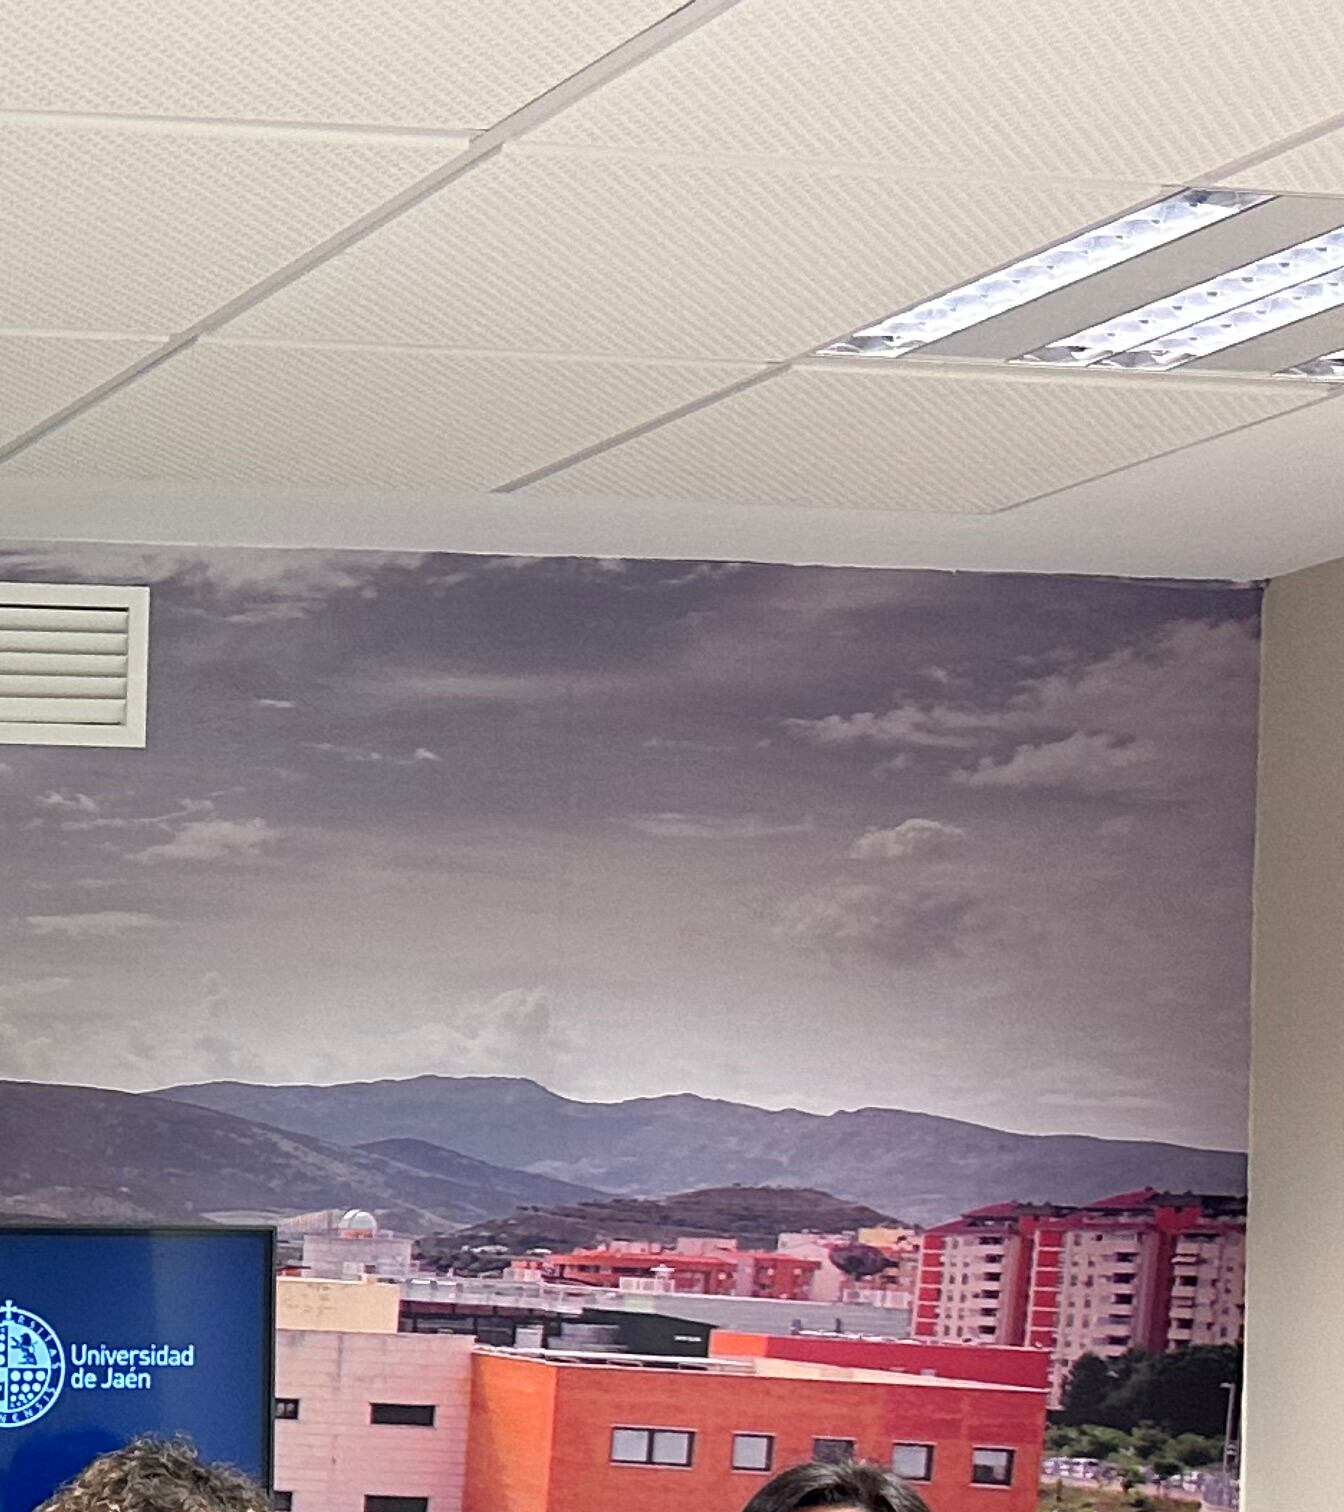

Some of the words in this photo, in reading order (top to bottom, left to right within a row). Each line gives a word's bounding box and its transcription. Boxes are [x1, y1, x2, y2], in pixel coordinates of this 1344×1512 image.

[70, 1343, 195, 1367] Universidad
[70, 1367, 96, 1390] de
[100, 1366, 151, 1390] Jaén
